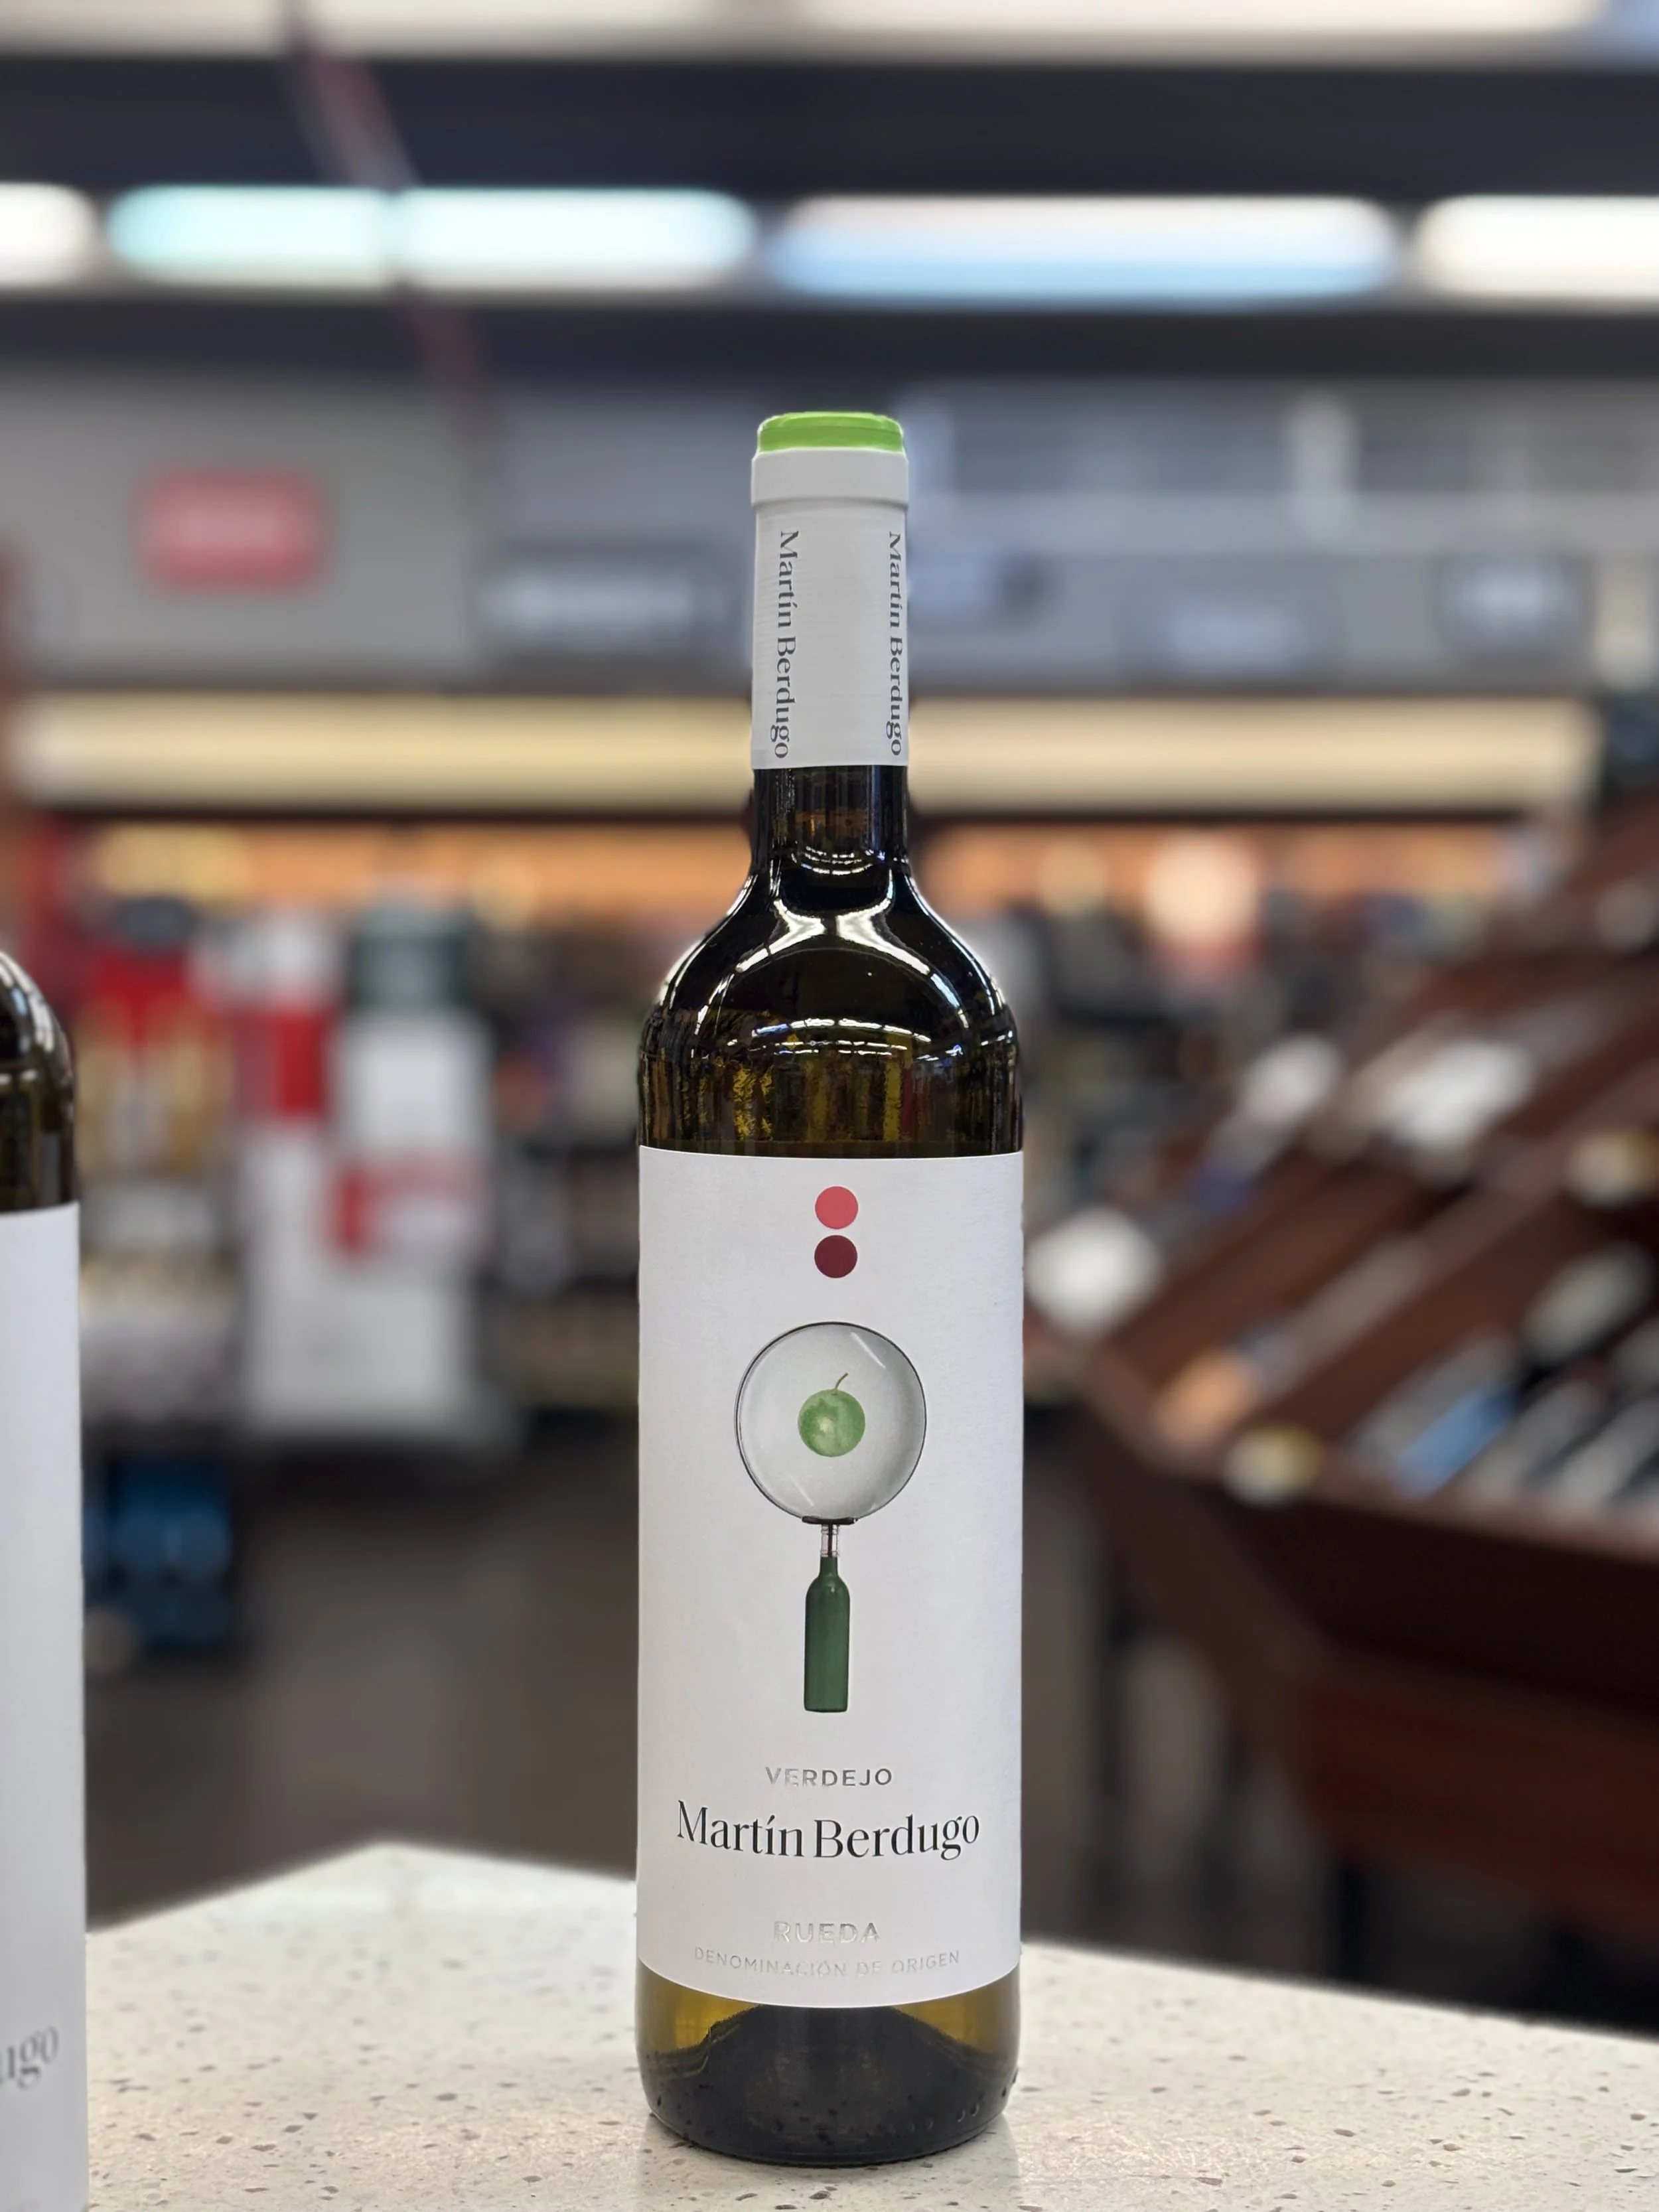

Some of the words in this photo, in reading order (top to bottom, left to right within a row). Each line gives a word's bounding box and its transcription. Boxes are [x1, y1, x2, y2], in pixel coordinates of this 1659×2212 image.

[778, 531, 799, 628] Martín
[889, 531, 902, 628] Martín
[770, 636, 796, 759] Berdugo
[886, 636, 903, 756] Berdugo
[764, 1766, 893, 1787] VERDEJO
[676, 1800, 804, 1857] Martín
[813, 1813, 980, 1860] Berdugo
[694, 1946, 847, 1977] DENOMINACIÓN
[856, 1961, 881, 1975] DE
[892, 1951, 960, 1974] ORIGEN
[773, 1921, 881, 1944] RUEDA
